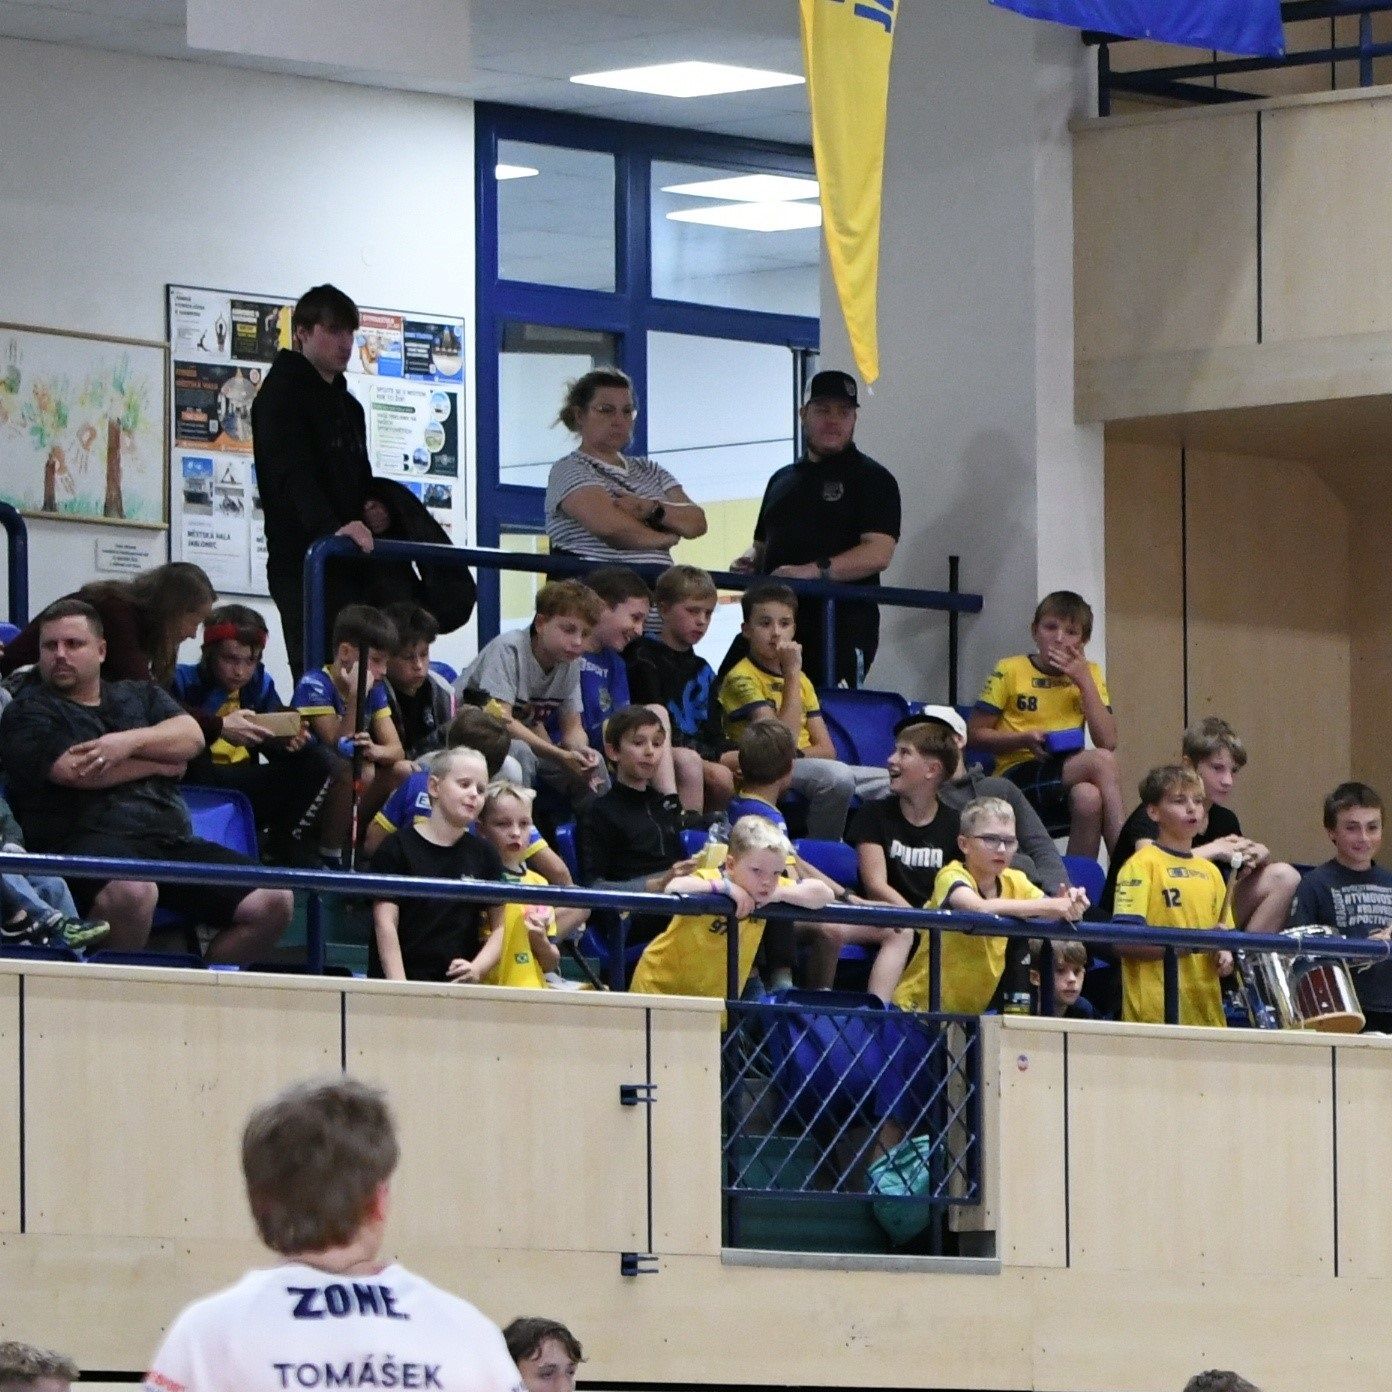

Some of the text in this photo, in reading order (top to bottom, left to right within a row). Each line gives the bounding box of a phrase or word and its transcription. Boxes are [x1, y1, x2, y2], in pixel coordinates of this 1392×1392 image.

[1016, 693, 1038, 712] 68
[1162, 888, 1182, 908] 12
[272, 1352, 446, 1391] TOMÁŠEK
